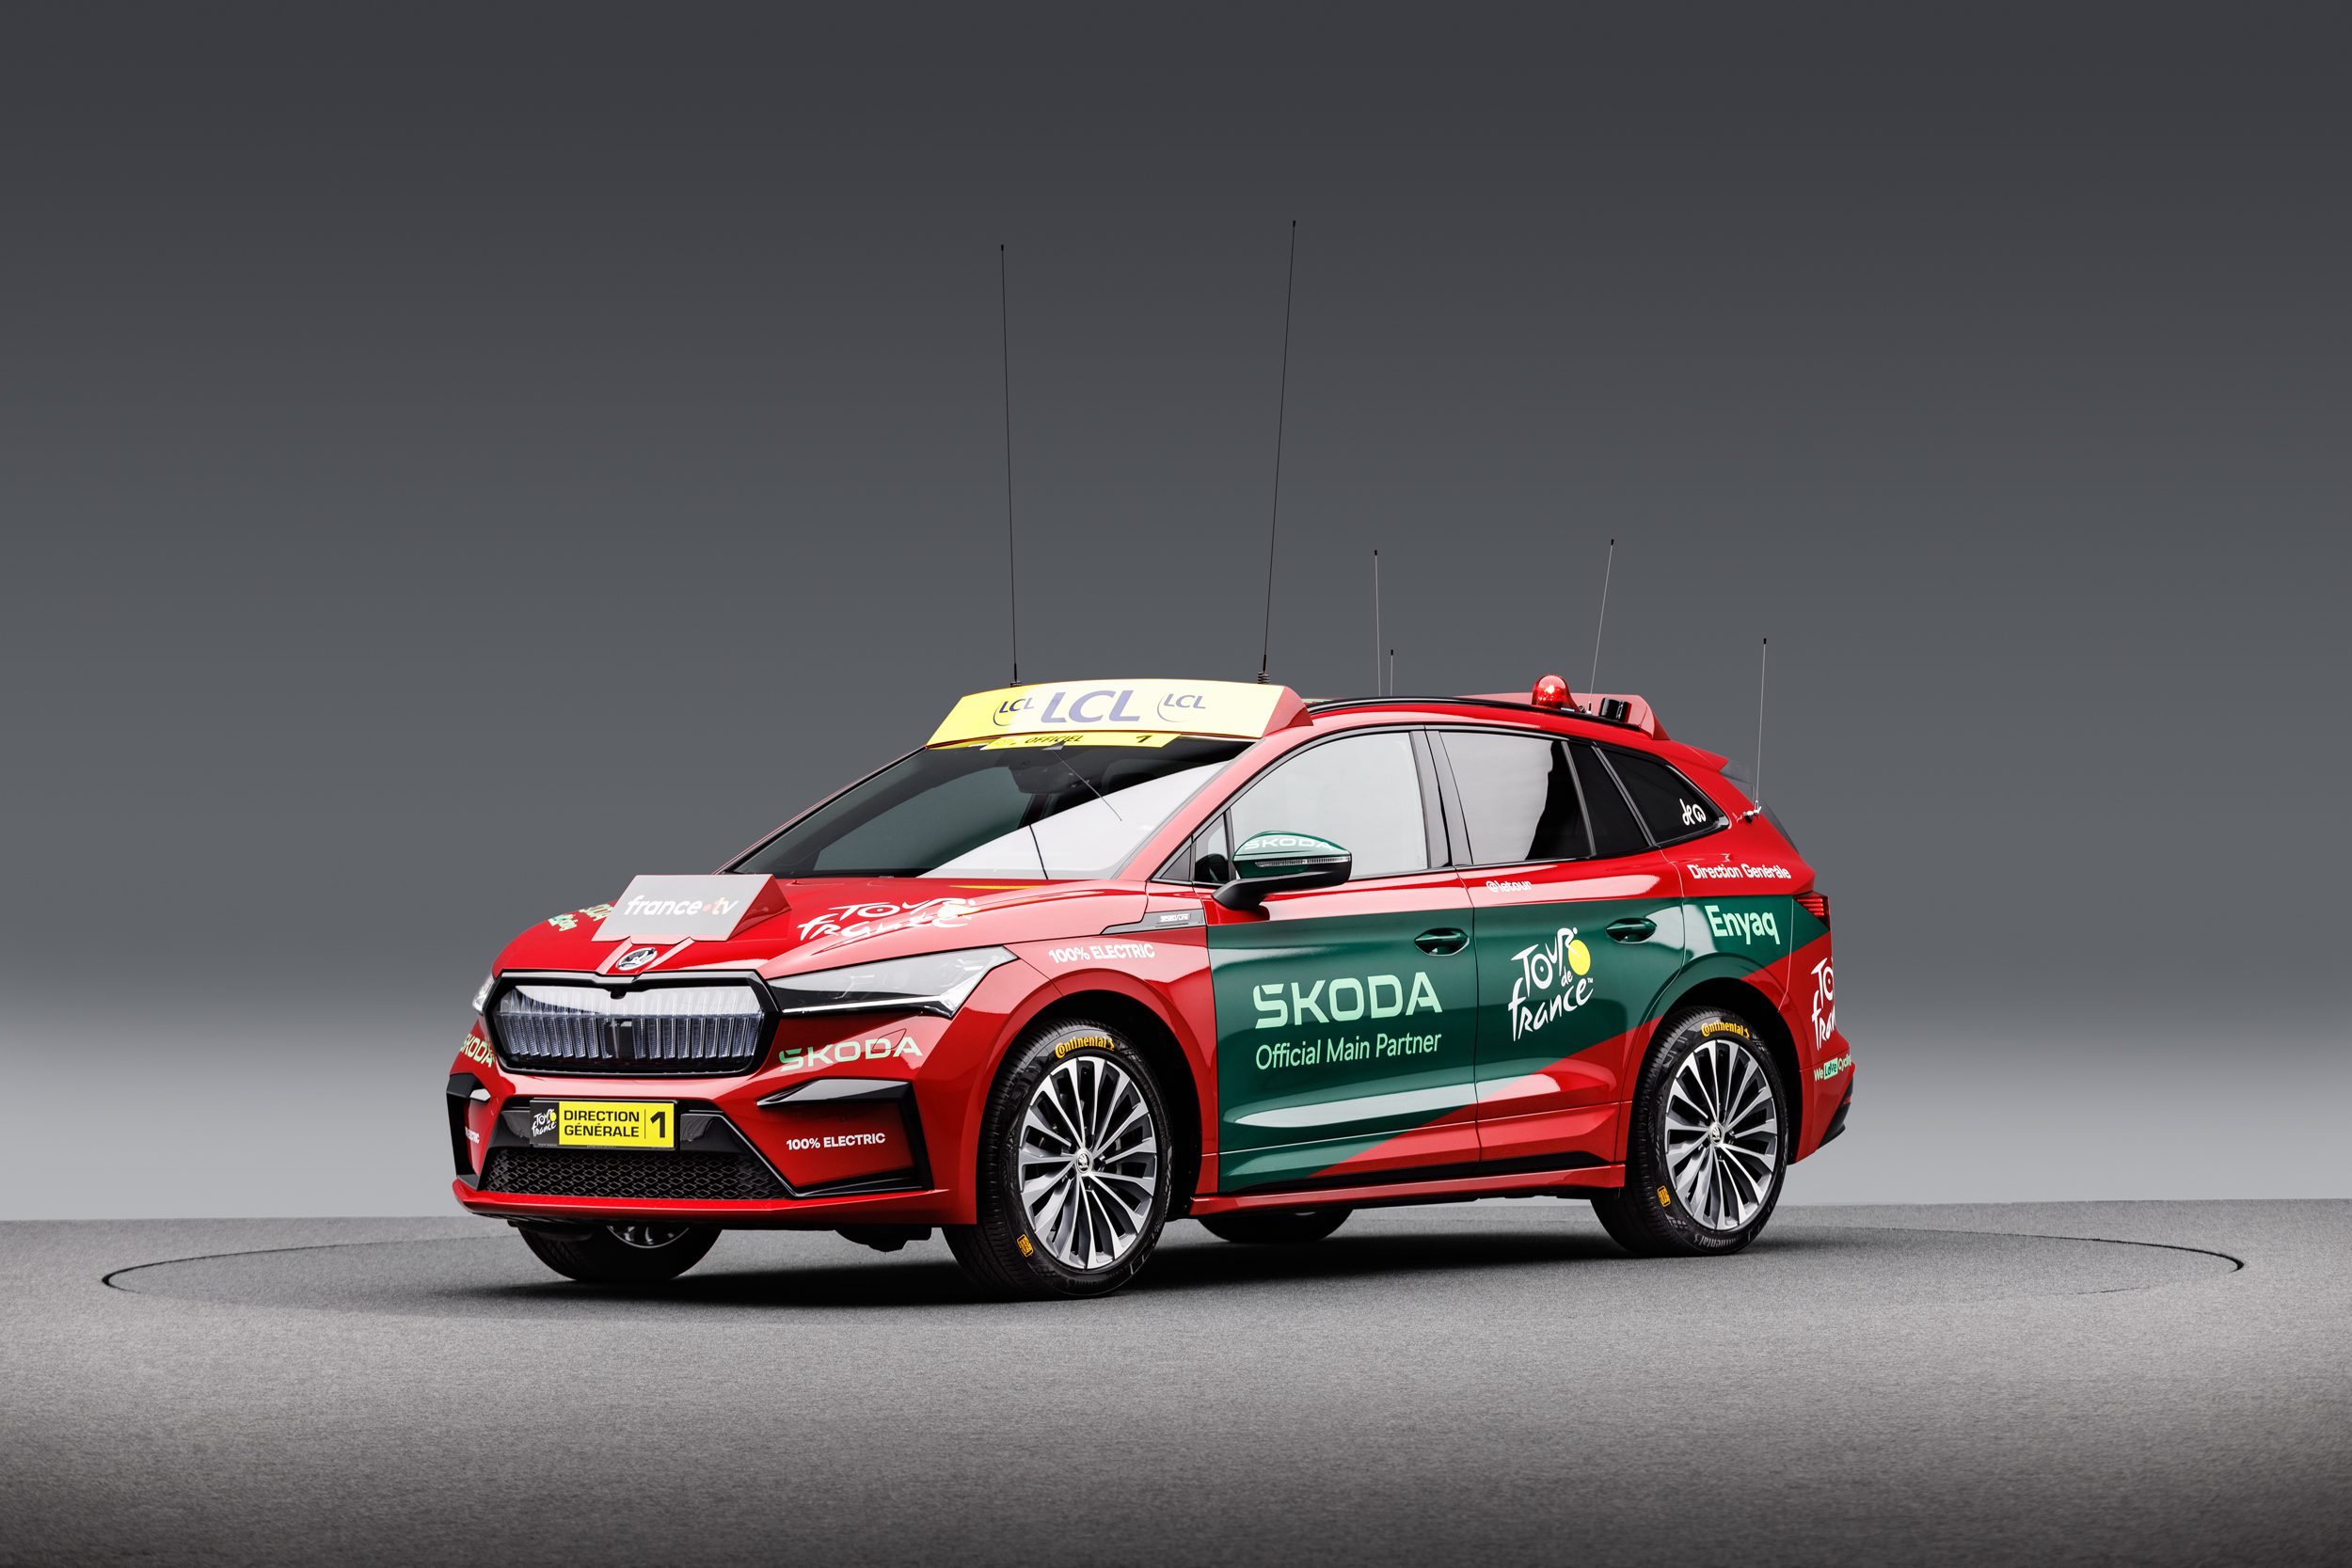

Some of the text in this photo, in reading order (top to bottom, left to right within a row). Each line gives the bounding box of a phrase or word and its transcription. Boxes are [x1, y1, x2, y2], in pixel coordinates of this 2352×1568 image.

[999, 697, 1035, 714] LCL
[1041, 690, 1140, 723] LCL
[1163, 693, 1206, 709] LCL
[1136, 735, 1153, 743] 1
[1687, 863, 1743, 879] Direction
[1705, 905, 1781, 945] Enyaq
[1048, 943, 1155, 963] 100% ELECTRIC
[1561, 966, 1573, 987] de
[1252, 972, 1443, 1029] SKODA
[1701, 1020, 1743, 1037] Continental
[779, 1037, 922, 1072] SKODA
[1055, 1036, 1107, 1059] Continental
[1255, 1032, 1442, 1070] Official Main Partner
[1825, 1063, 1836, 1076] Love
[564, 1110, 665, 1138] DIRECTION 1
[564, 1123, 639, 1137] GÉNÉRALE
[786, 1132, 886, 1150] 100% ELECTRIC
